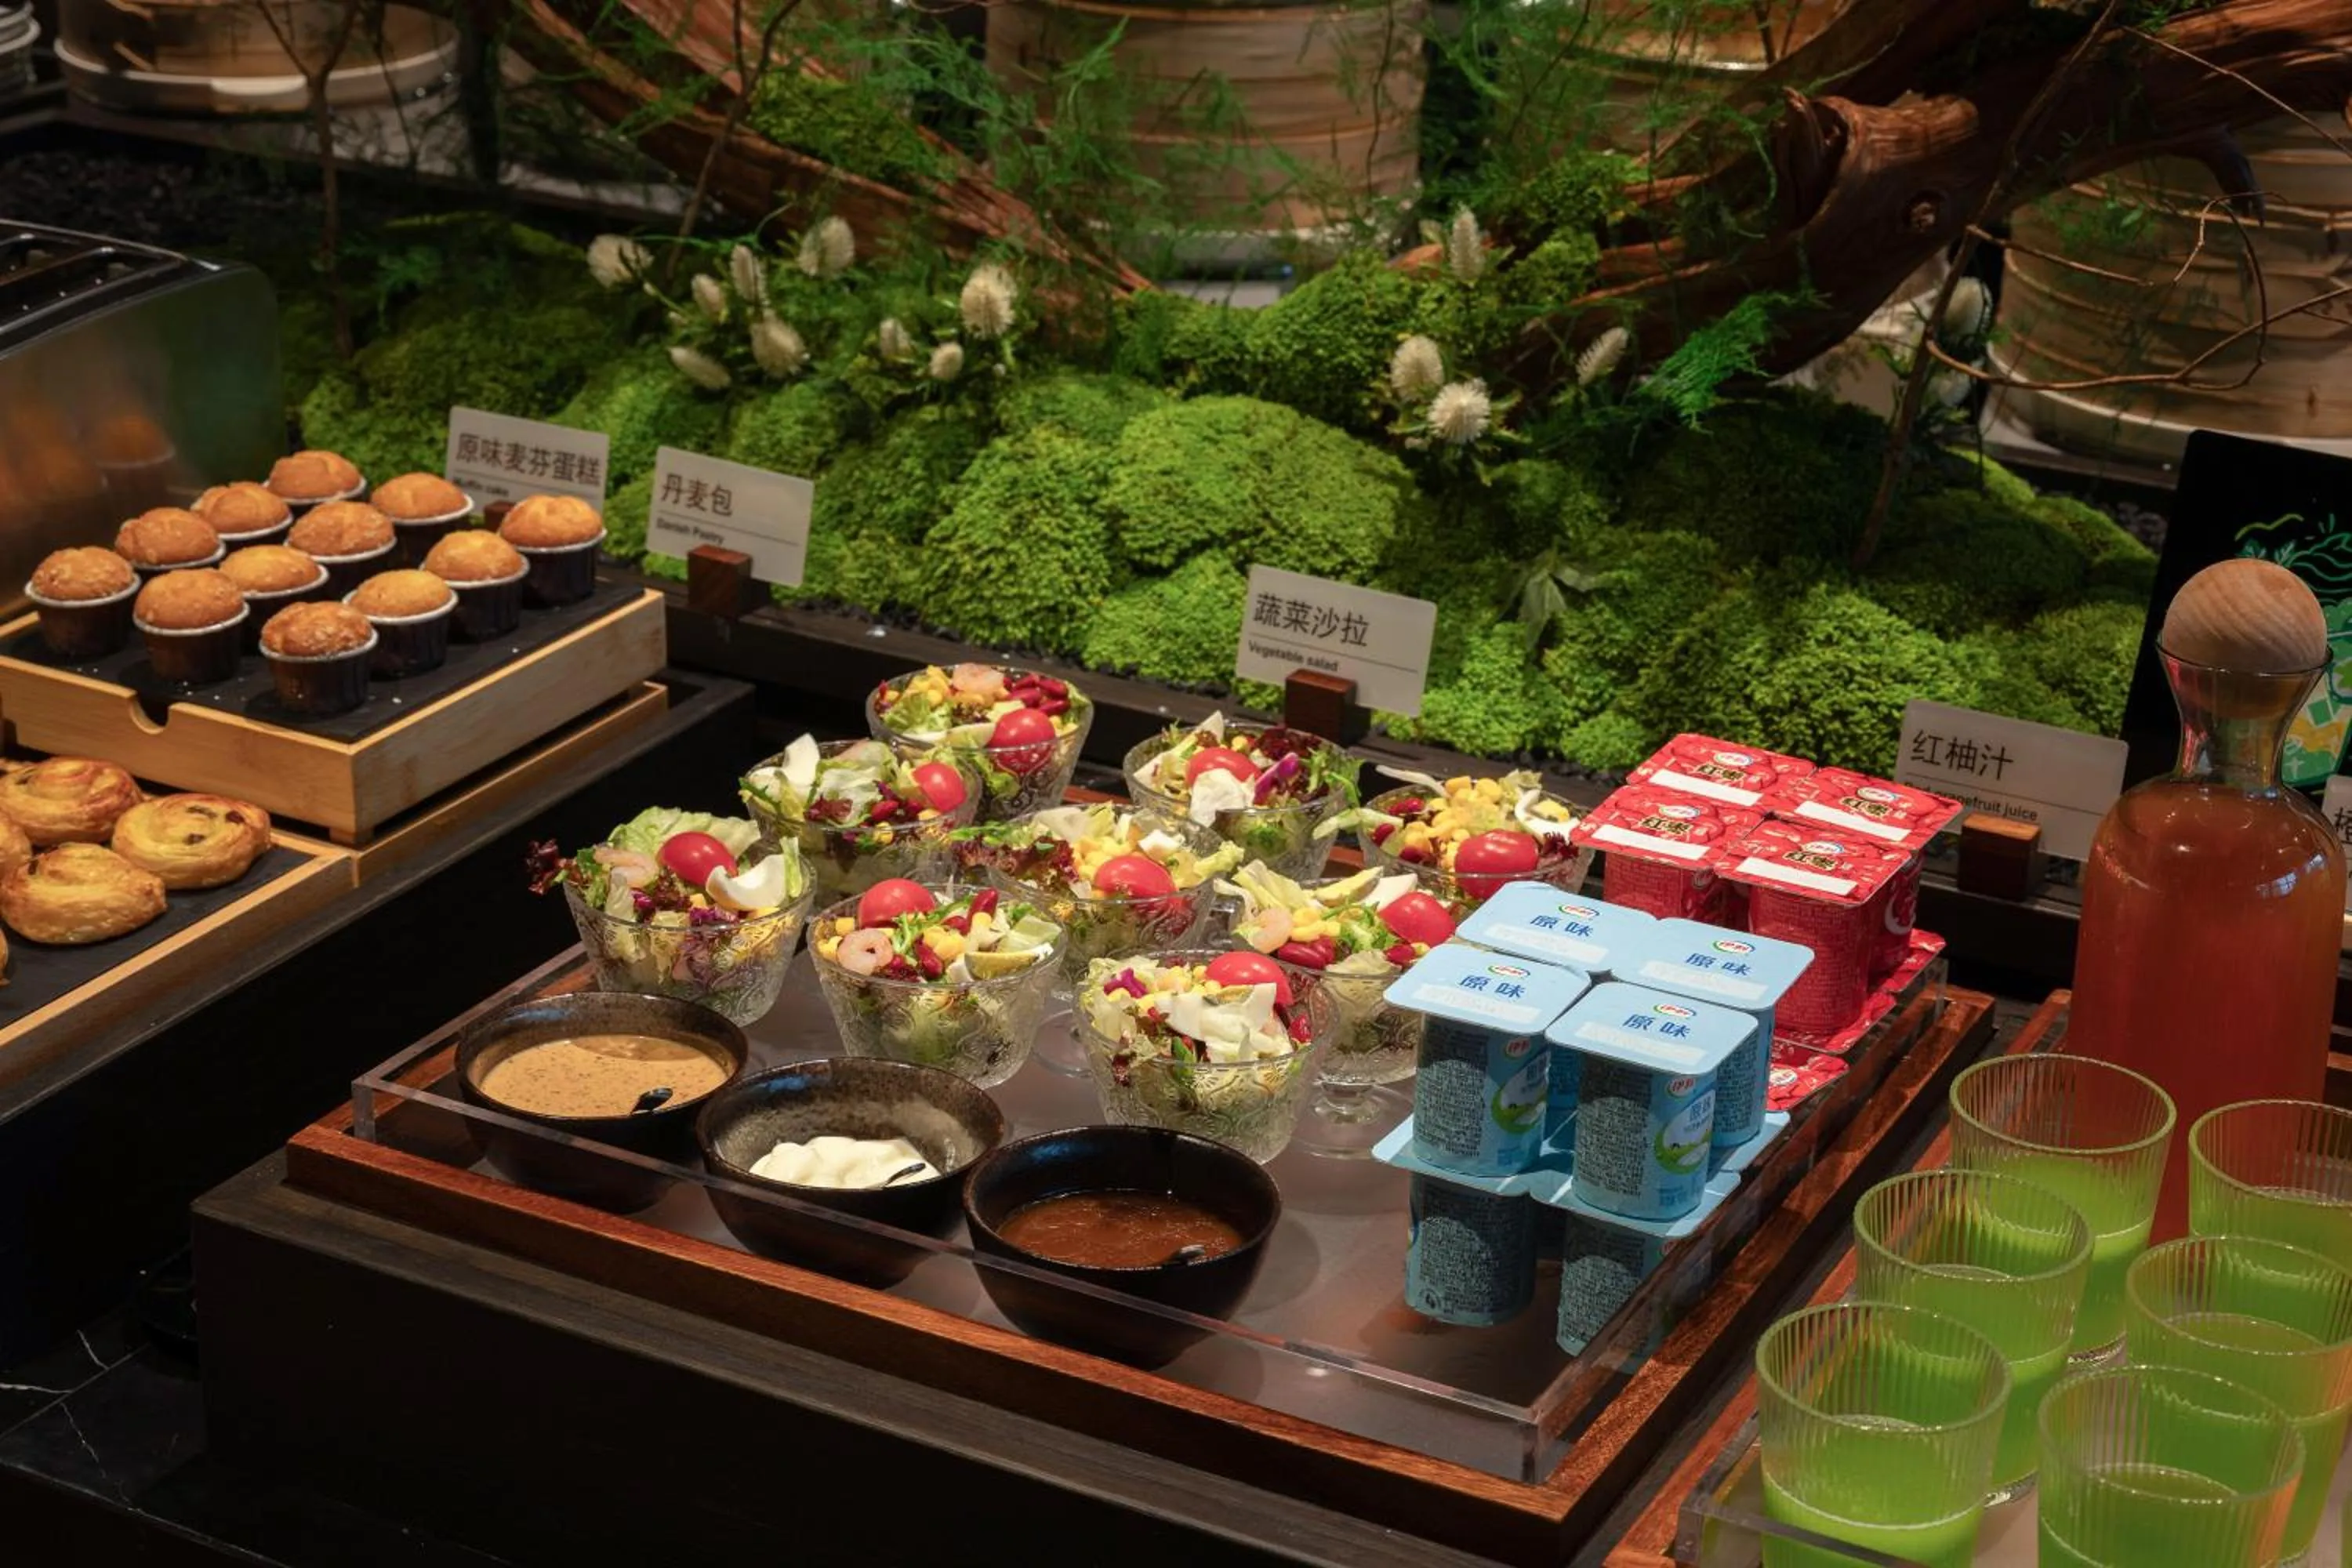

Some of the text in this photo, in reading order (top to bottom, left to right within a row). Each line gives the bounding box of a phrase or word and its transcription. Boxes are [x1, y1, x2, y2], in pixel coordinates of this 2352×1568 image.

[456, 432, 601, 487] 原味麦芬蛋糕
[660, 473, 733, 517] 丹麦包
[1253, 591, 1369, 648] 蔬菜沙拉
[1248, 639, 1338, 673] Vegetable salad
[1910, 729, 2014, 781] 红柚汁
[2002, 804, 2038, 822] juice
[1529, 915, 1594, 937] 原味
[1685, 953, 1751, 975] 原味
[1459, 975, 1526, 998] 原味
[1622, 1014, 1691, 1037] 原味
